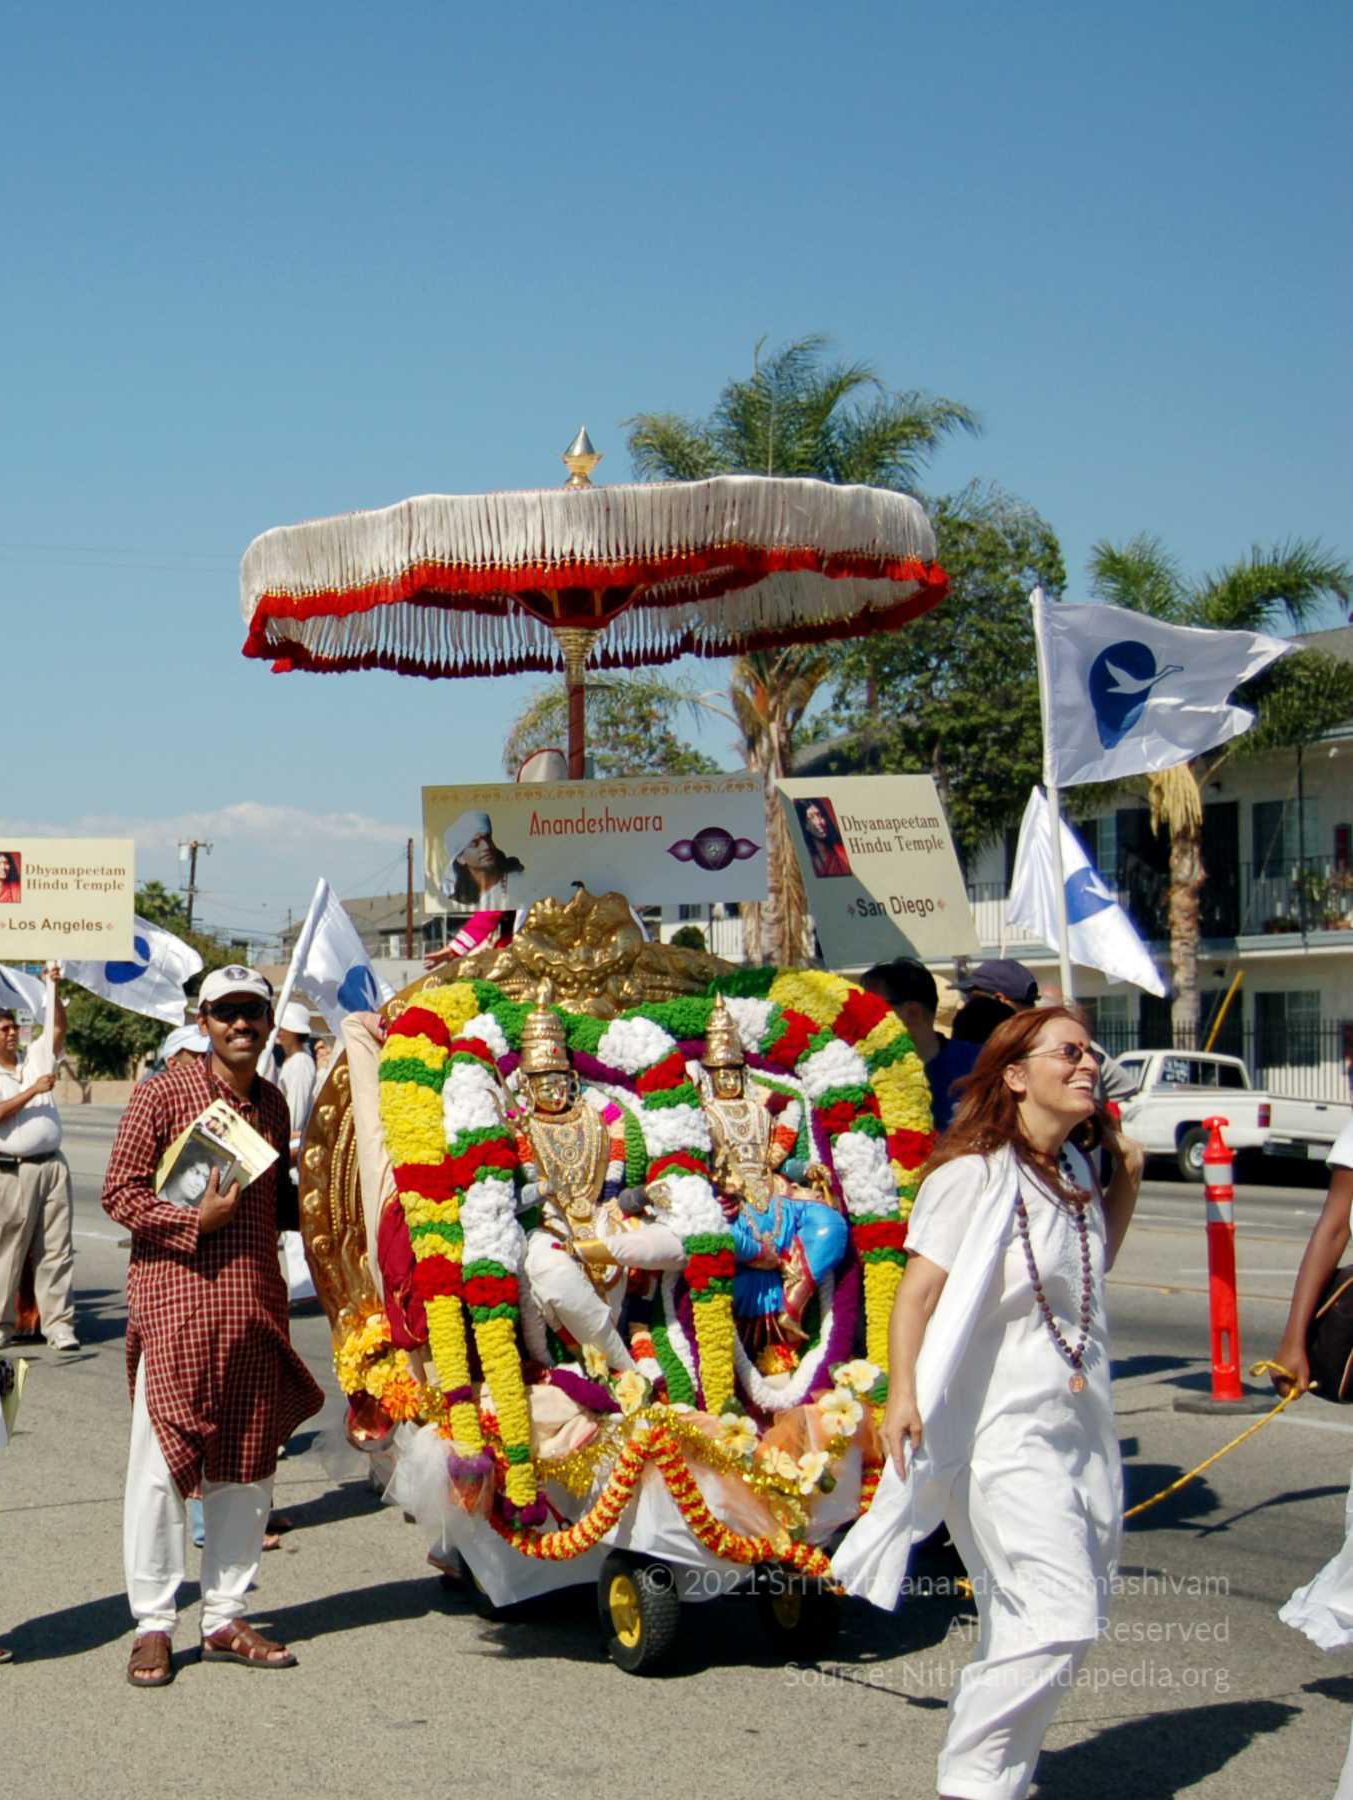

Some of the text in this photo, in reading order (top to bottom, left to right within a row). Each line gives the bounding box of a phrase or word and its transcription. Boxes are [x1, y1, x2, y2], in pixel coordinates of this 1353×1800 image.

[529, 806, 663, 837] Anandeshwara
[839, 815, 940, 834] Dhyanapeetam
[848, 834, 945, 854] Hindu Temple
[25, 863, 126, 877] Dhyanapeetam
[27, 878, 125, 892] Hindu Temple
[855, 895, 935, 918] San Diego
[8, 917, 103, 934] Los Angeles
